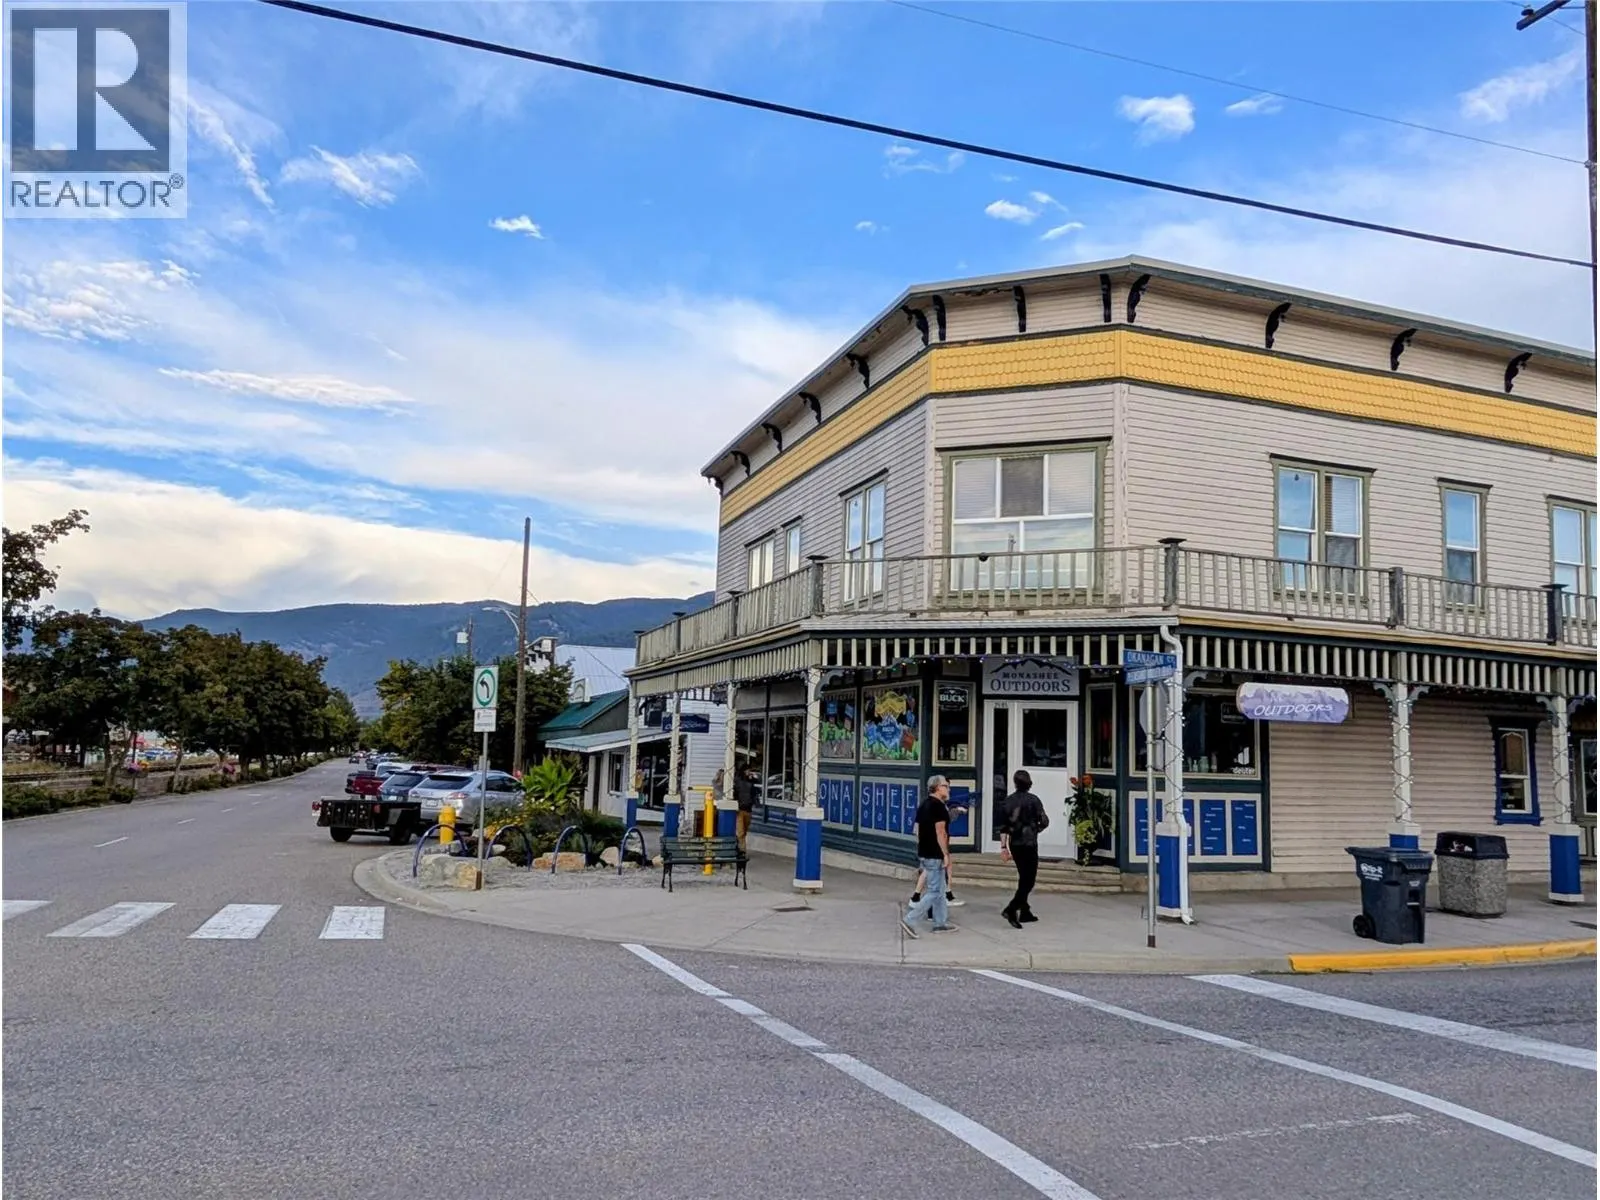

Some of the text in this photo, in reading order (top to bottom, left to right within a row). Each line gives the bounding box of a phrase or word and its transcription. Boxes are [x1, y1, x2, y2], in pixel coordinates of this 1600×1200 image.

[1127, 651, 1164, 665] OKANAGAN
[990, 679, 1071, 692] OUTDOORS
[940, 694, 965, 702] BUCK
[1254, 703, 1333, 716] OUTDOORS
